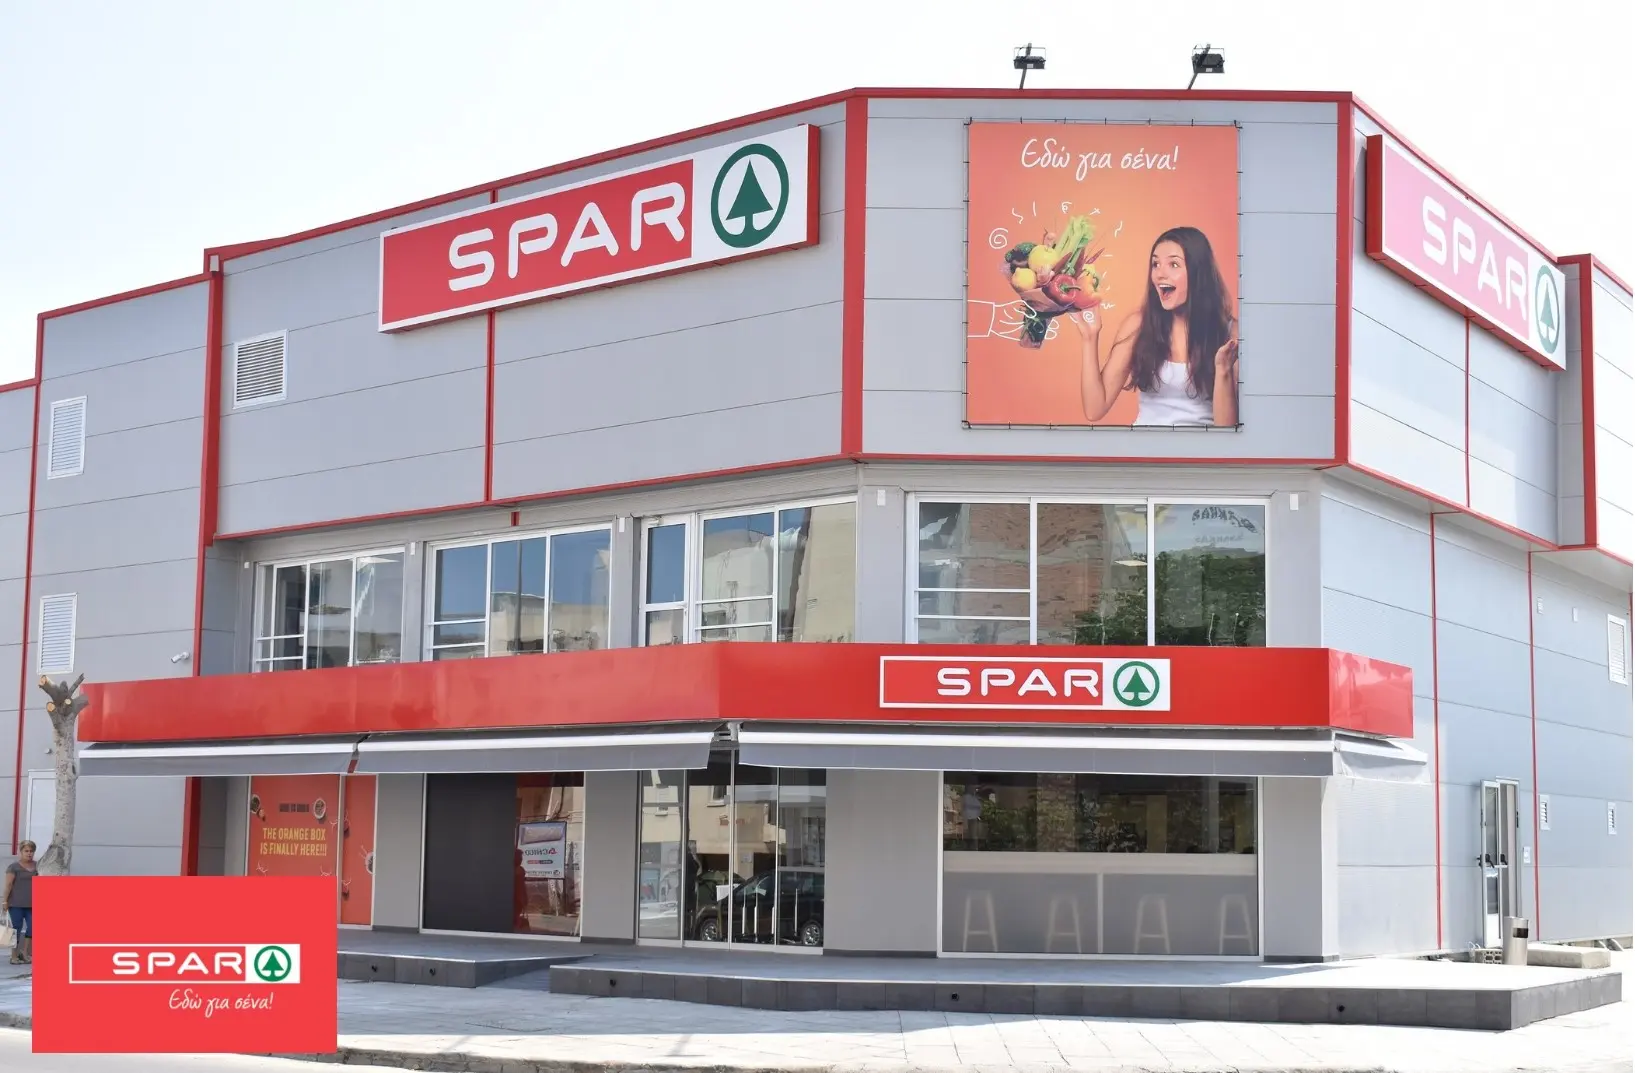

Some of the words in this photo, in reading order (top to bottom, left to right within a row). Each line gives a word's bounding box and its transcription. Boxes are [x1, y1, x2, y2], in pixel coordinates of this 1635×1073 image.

[1020, 137, 1071, 169] Εδώ
[1075, 150, 1113, 181] για
[1120, 145, 1179, 170] σένα!
[448, 181, 686, 292] SPAR
[1422, 195, 1528, 321] SPAR
[937, 667, 1099, 698] SPAR
[260, 842, 268, 855] IS
[269, 842, 299, 856] FINALLY
[262, 827, 277, 840] THE
[278, 827, 309, 841] ORANGE
[310, 827, 326, 841] BOX
